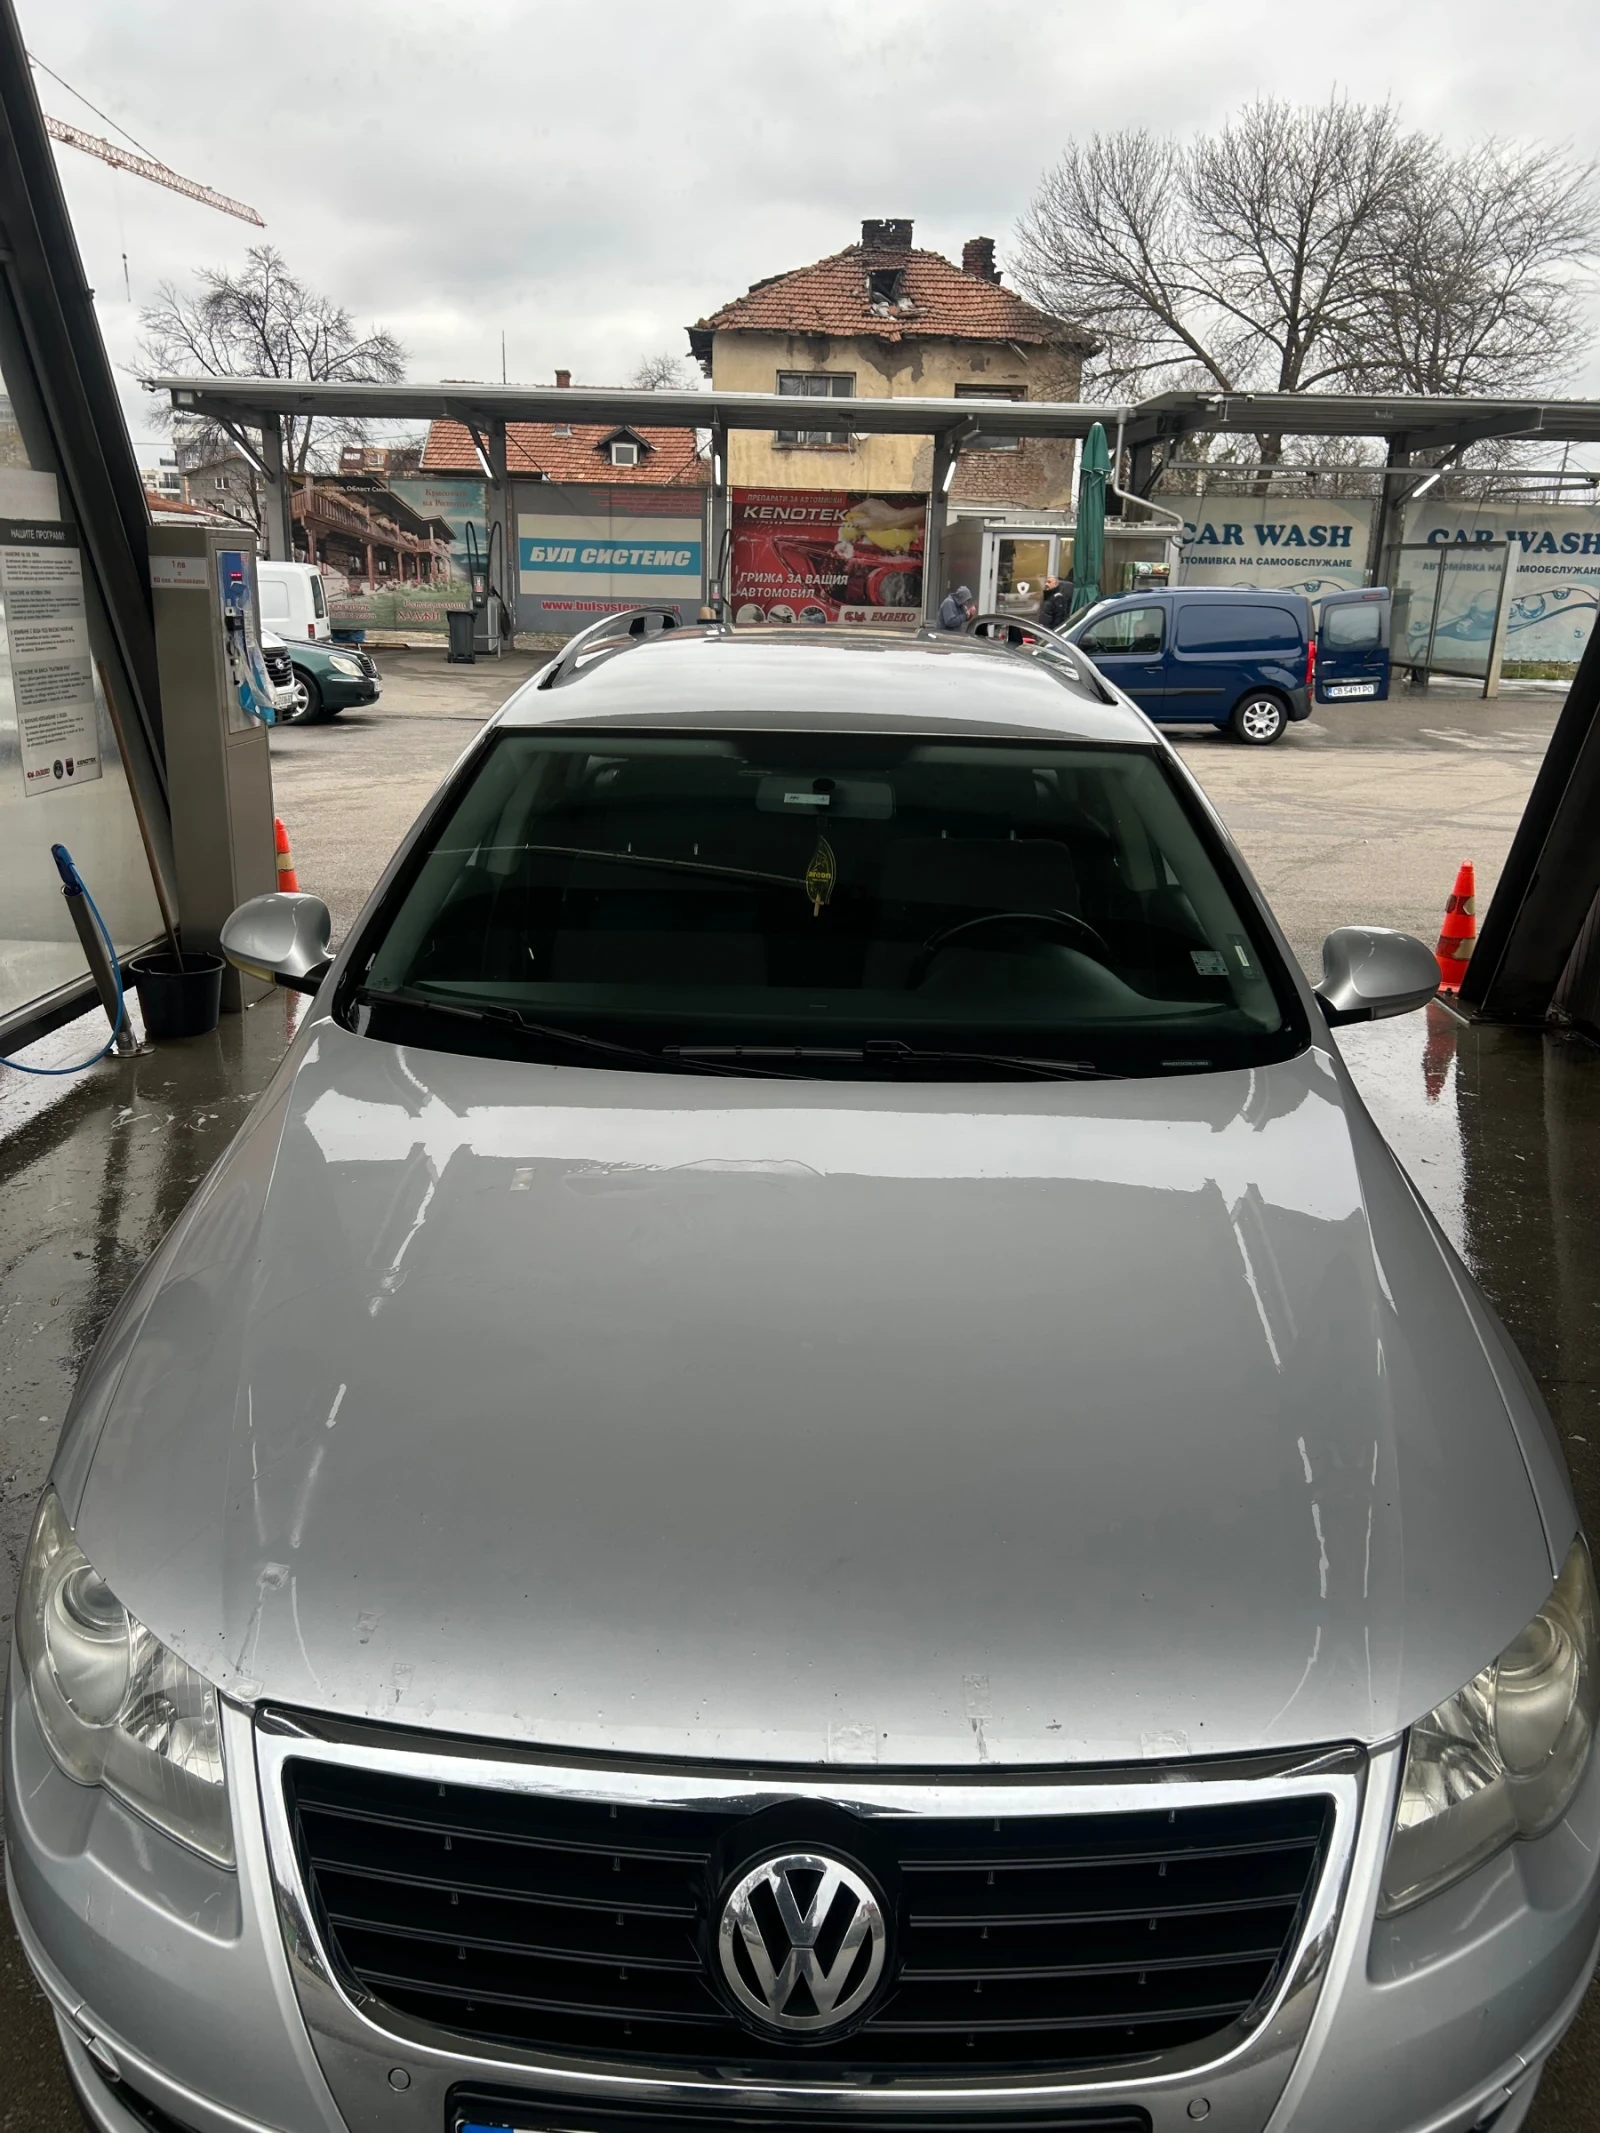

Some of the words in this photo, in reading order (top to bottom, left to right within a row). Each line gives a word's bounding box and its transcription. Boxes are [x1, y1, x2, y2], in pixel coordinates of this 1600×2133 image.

[747, 494, 788, 502] ПРЕПАРАТИ
[743, 506, 849, 521] KENOTEK
[10, 528, 35, 539] НАШИТЕ
[1182, 522, 1244, 545] CAR
[1254, 524, 1353, 547] WASH
[1506, 531, 1600, 554] WASH
[530, 546, 577, 563] БУЛ
[580, 548, 692, 567] СИСТЕМС
[1239, 557, 1253, 565] НА
[1256, 557, 1353, 567] САМООБСЛУЖАНЕ
[1488, 563, 1502, 572] НА
[740, 572, 783, 583] ГРИЖА
[786, 574, 801, 583] ЗА
[805, 574, 849, 586] ВАШИЯ
[740, 587, 815, 599] АВТОМОБИЛ
[870, 611, 916, 622] EMBEKO
